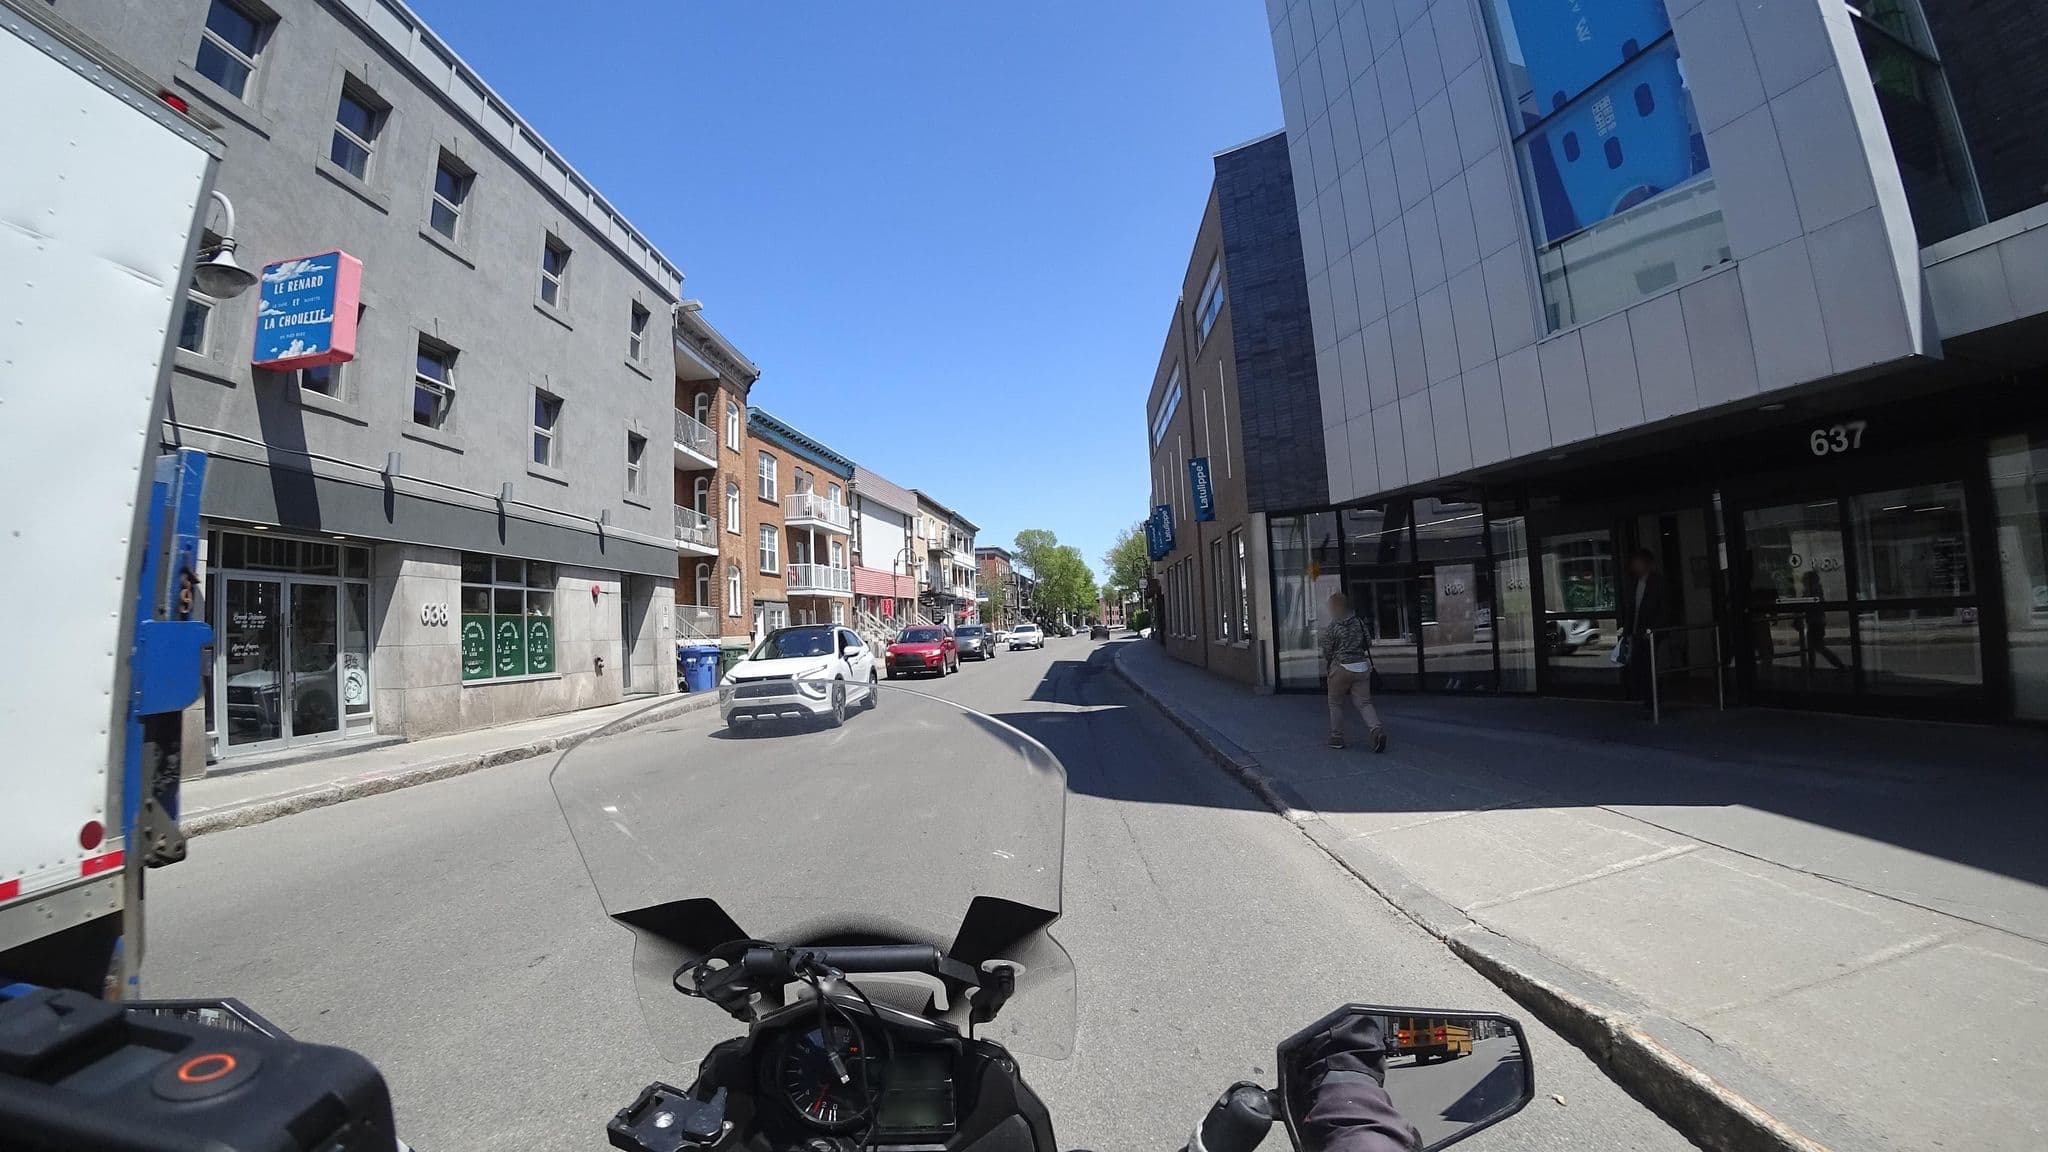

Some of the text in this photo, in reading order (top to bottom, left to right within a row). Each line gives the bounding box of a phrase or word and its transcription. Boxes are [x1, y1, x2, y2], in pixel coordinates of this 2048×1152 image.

[274, 275, 323, 295] LE RENARD
[292, 298, 300, 307] ET
[264, 309, 326, 330] LA CHOUETTE
[1811, 421, 1867, 455] 637
[1196, 465, 1209, 509] Latulippe
